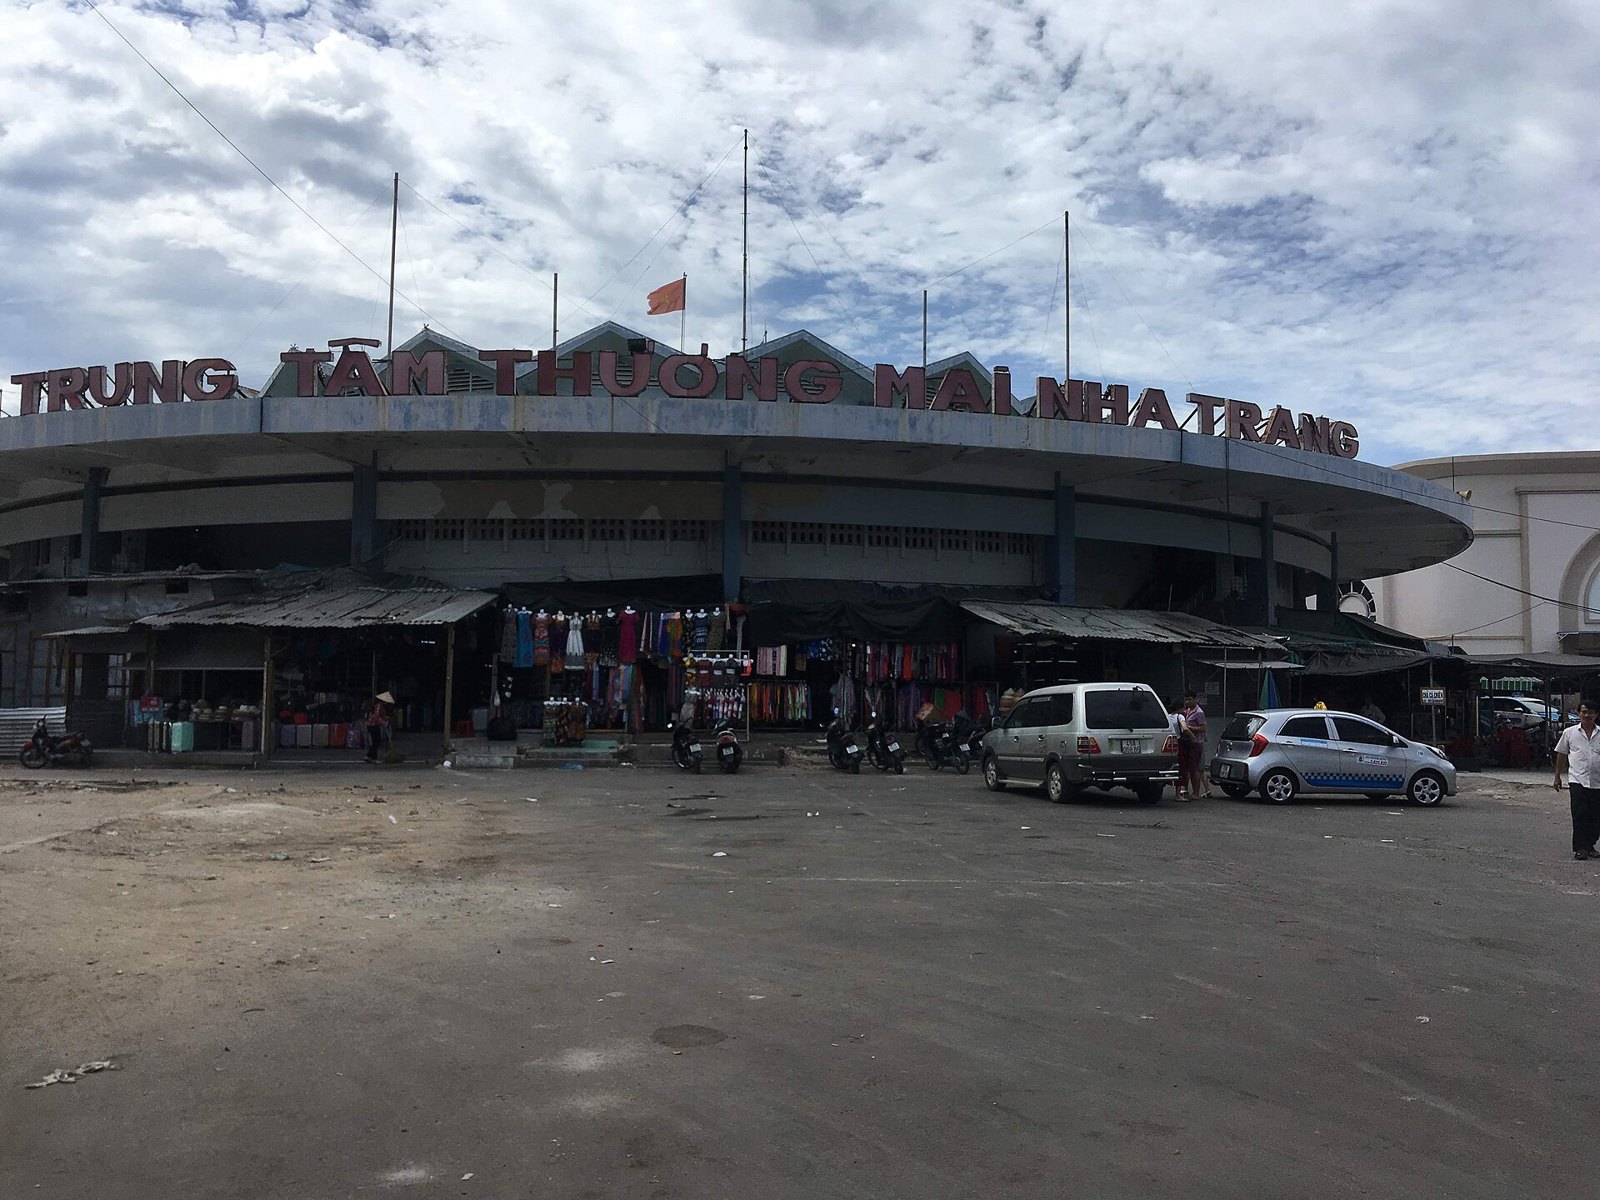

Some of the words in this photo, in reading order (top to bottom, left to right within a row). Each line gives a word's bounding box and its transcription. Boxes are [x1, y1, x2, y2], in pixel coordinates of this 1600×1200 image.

[11, 358, 238, 416] TRUNG
[1037, 376, 1179, 430] NHA
[1186, 392, 1360, 460] TRANG
